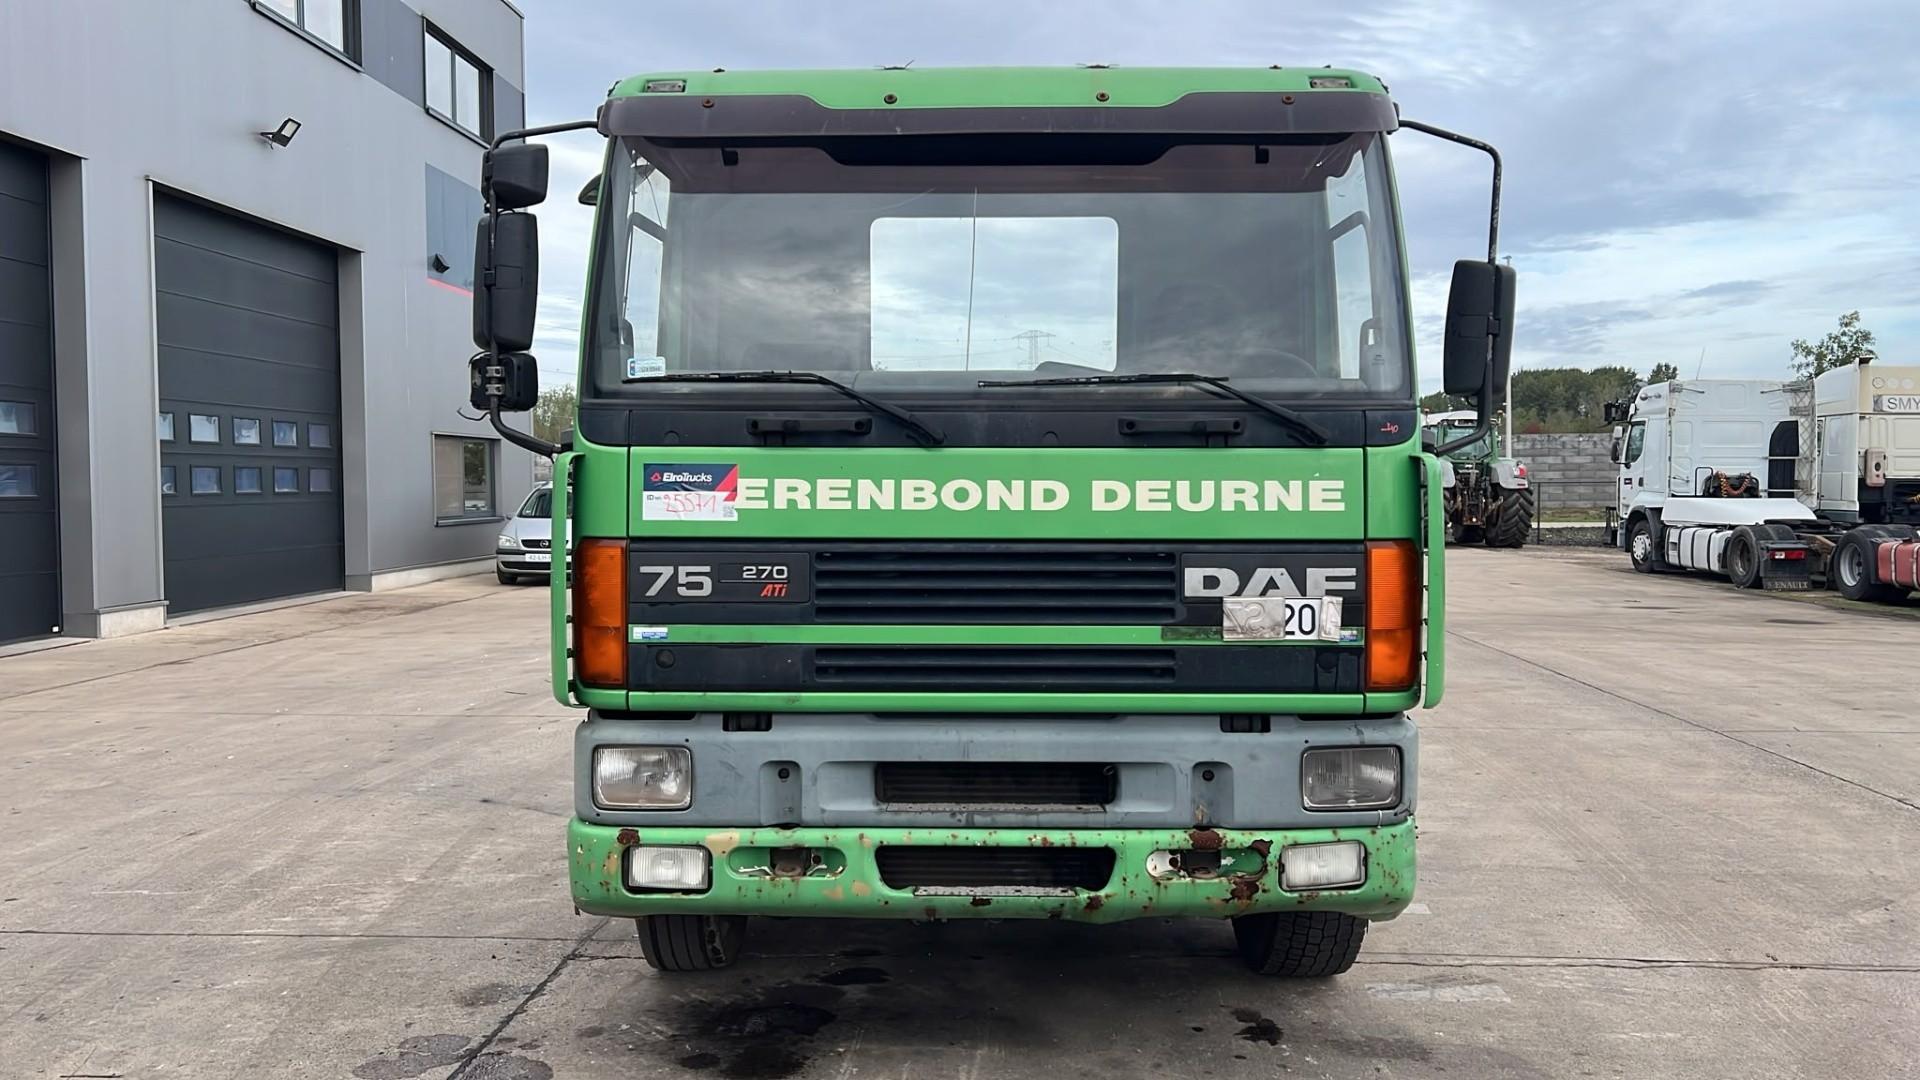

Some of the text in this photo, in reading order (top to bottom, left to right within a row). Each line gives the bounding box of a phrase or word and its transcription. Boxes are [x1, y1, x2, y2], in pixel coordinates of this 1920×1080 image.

[663, 472, 713, 482] ElroTrucks
[664, 493, 717, 513] 25571
[735, 478, 1070, 512] ERENBOND
[639, 566, 713, 597] 75
[742, 566, 788, 579] 270
[1184, 567, 1357, 598] DAF
[760, 583, 788, 597] ATi
[1285, 603, 1316, 635] 20
